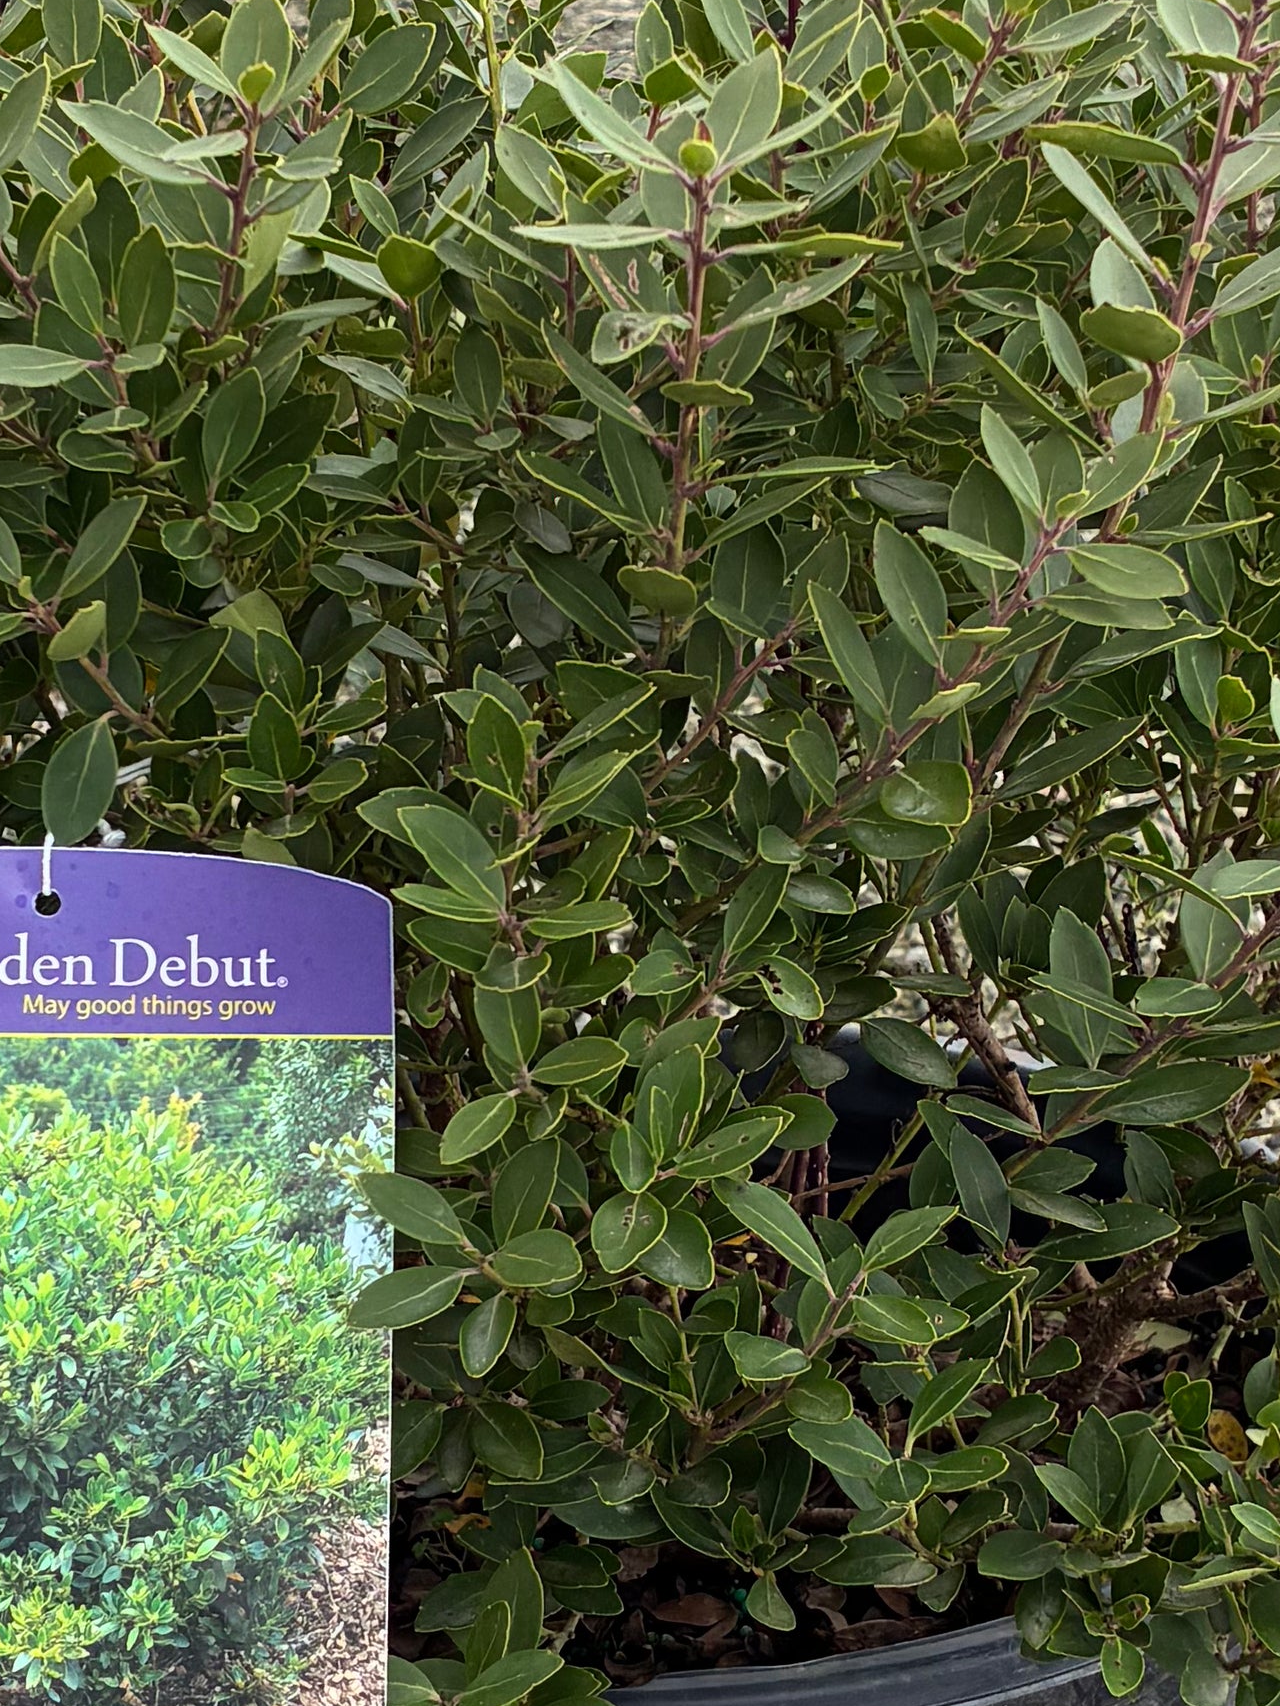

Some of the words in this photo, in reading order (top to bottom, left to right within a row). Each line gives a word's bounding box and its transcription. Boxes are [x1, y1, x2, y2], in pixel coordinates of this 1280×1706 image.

[22, 993, 71, 1021] May
[75, 993, 137, 1021] good
[141, 993, 214, 1022] things
[218, 999, 277, 1021] grow
